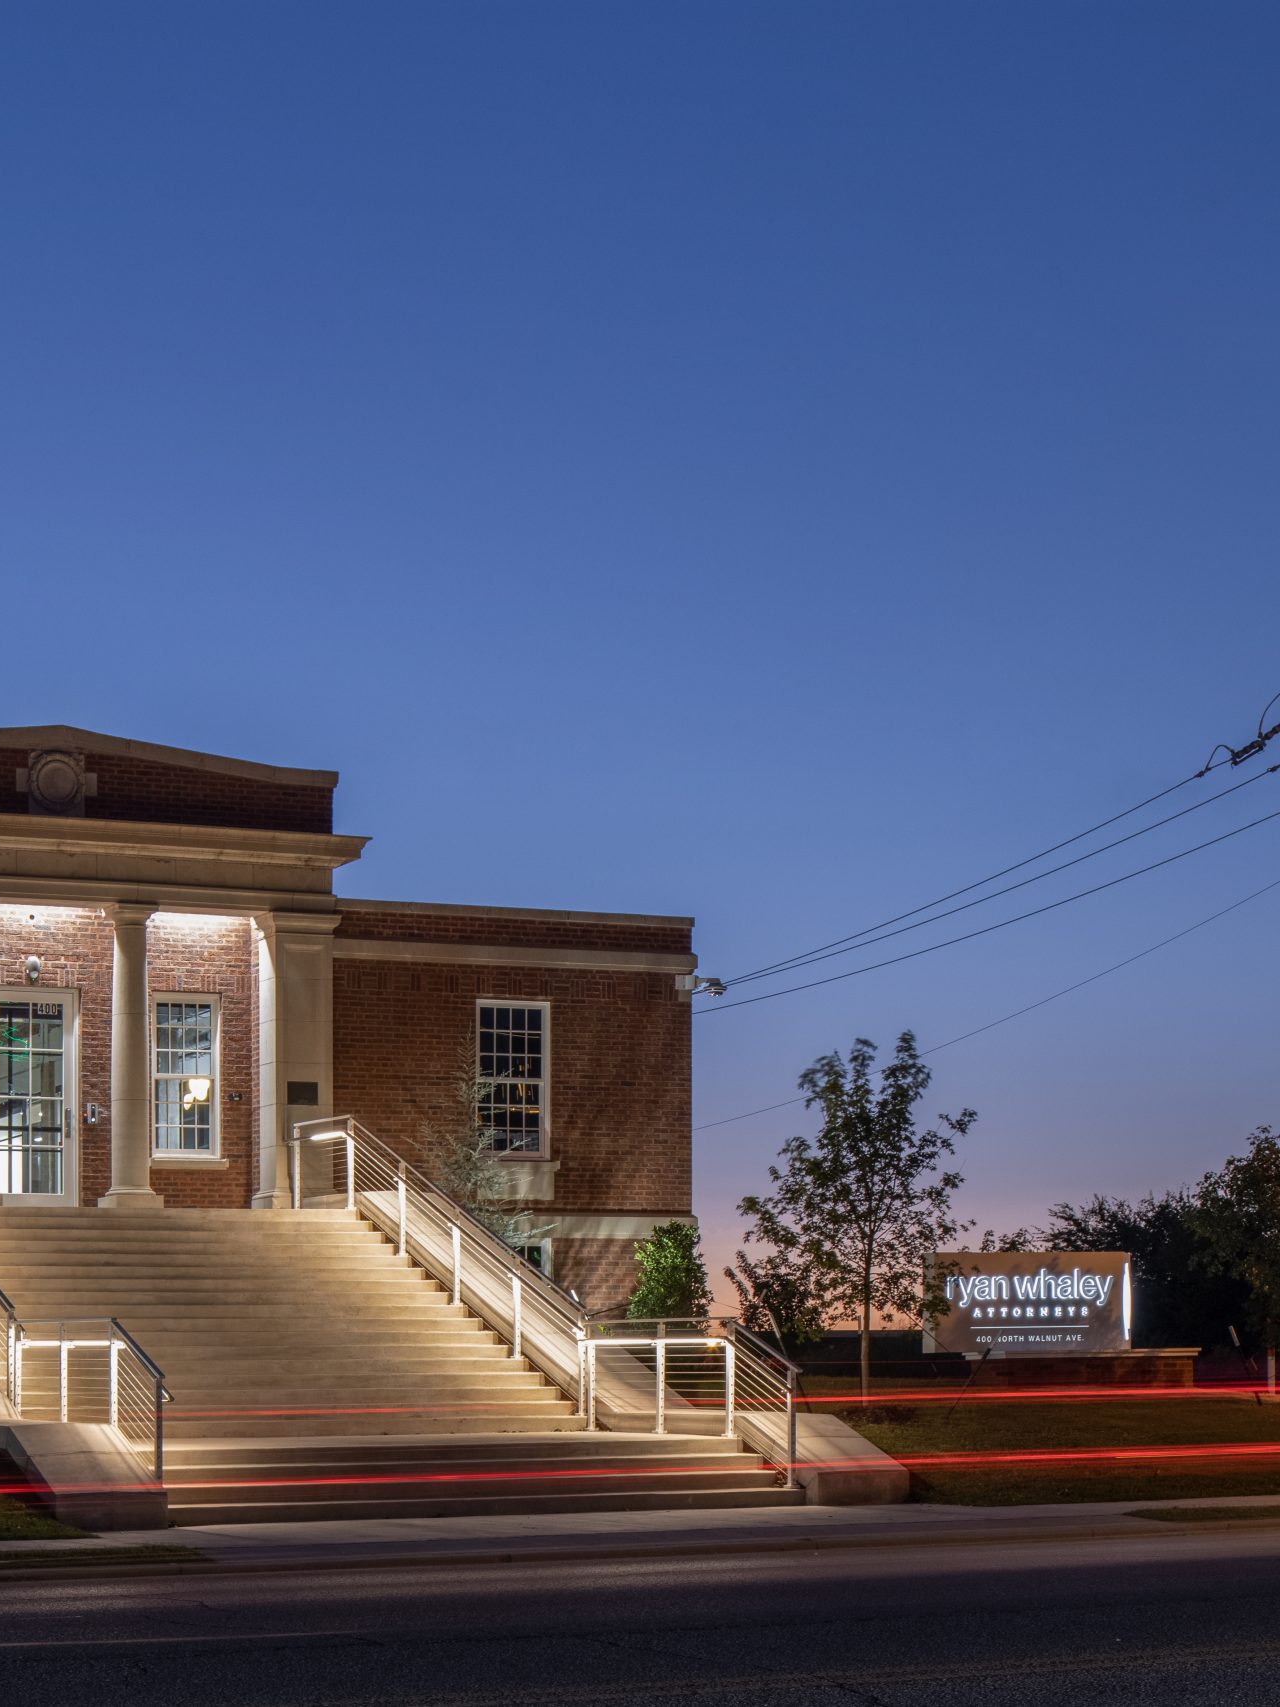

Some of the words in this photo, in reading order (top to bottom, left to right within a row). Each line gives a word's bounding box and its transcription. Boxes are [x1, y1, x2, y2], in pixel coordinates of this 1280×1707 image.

[38, 1003, 57, 1014] 400
[946, 1275, 1010, 1308] ryan
[1014, 1269, 1113, 1306] whaley
[972, 1307, 1089, 1318] ATTORNEYS
[976, 1335, 992, 1343] 400
[1028, 1334, 1062, 1343] WALNUT
[1066, 1334, 1085, 1342] AVE.
